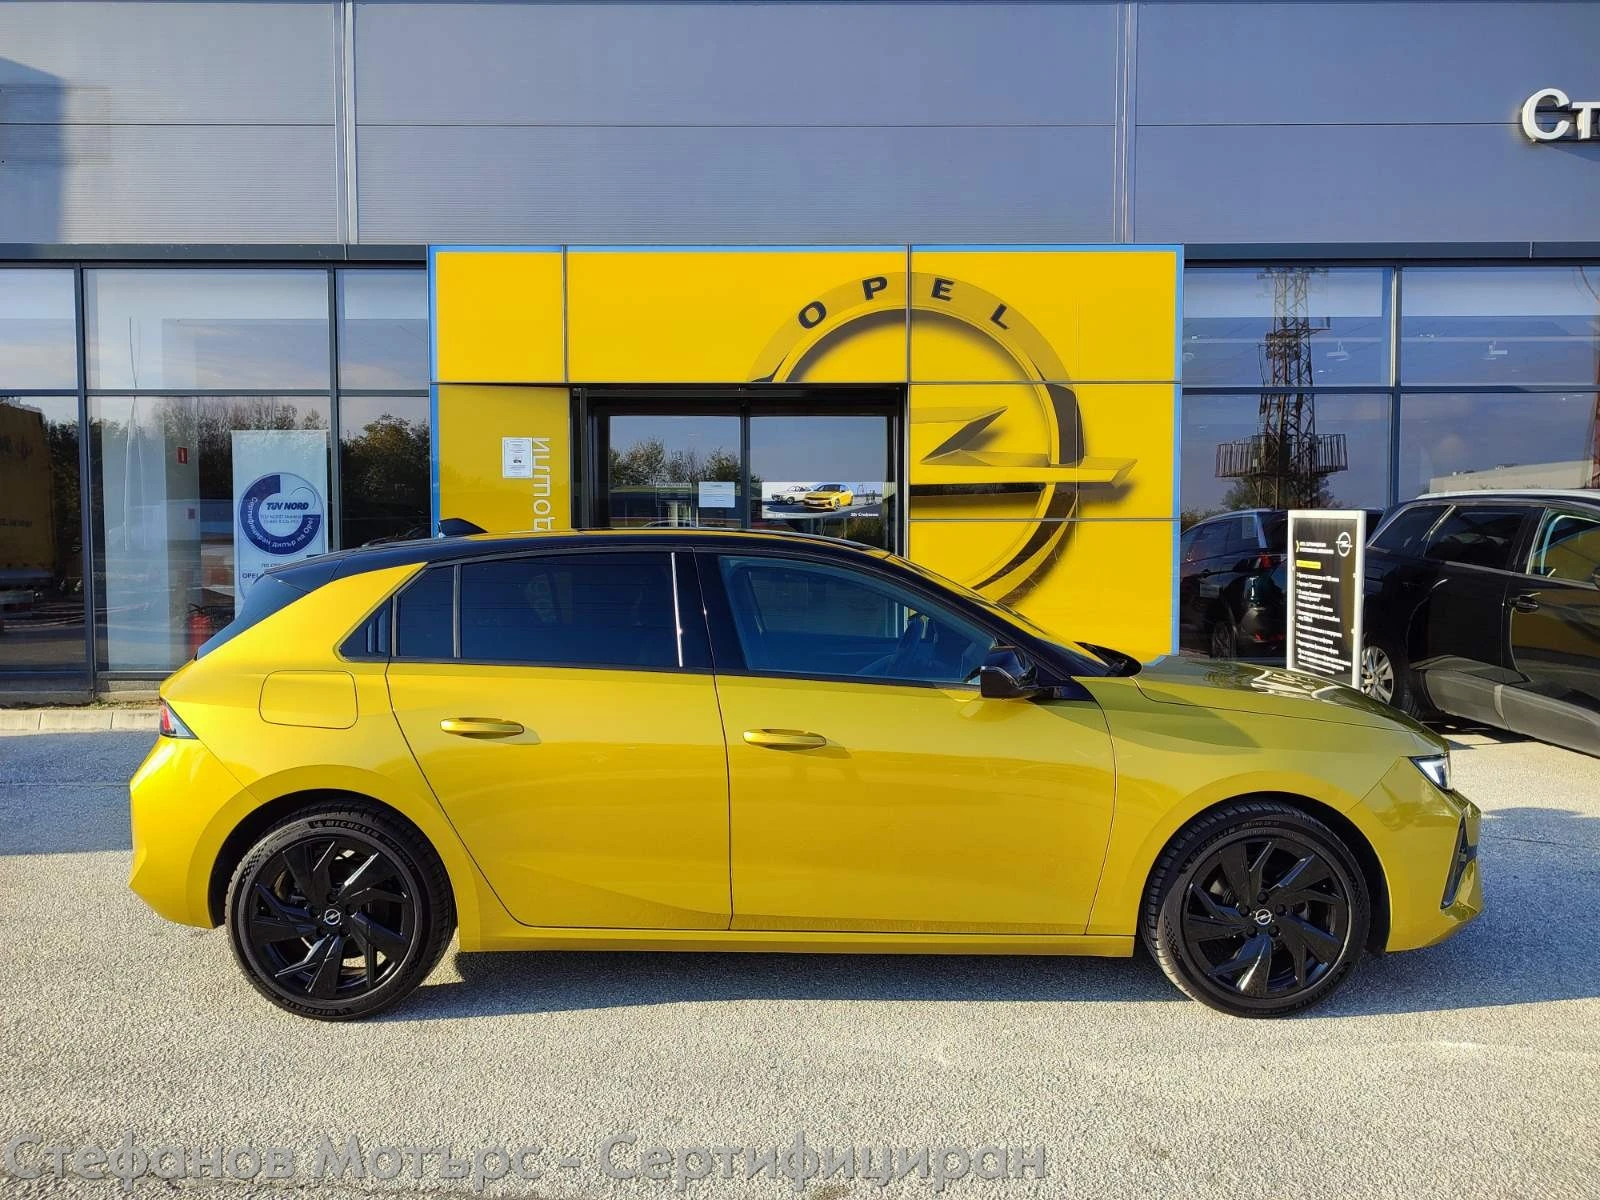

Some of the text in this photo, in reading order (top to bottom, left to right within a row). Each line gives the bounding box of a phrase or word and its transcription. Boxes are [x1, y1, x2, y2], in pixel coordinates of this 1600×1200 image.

[797, 276, 1010, 330] OPEL
[266, 502, 309, 511] TÜV NORD
[303, 517, 314, 534] Opel
